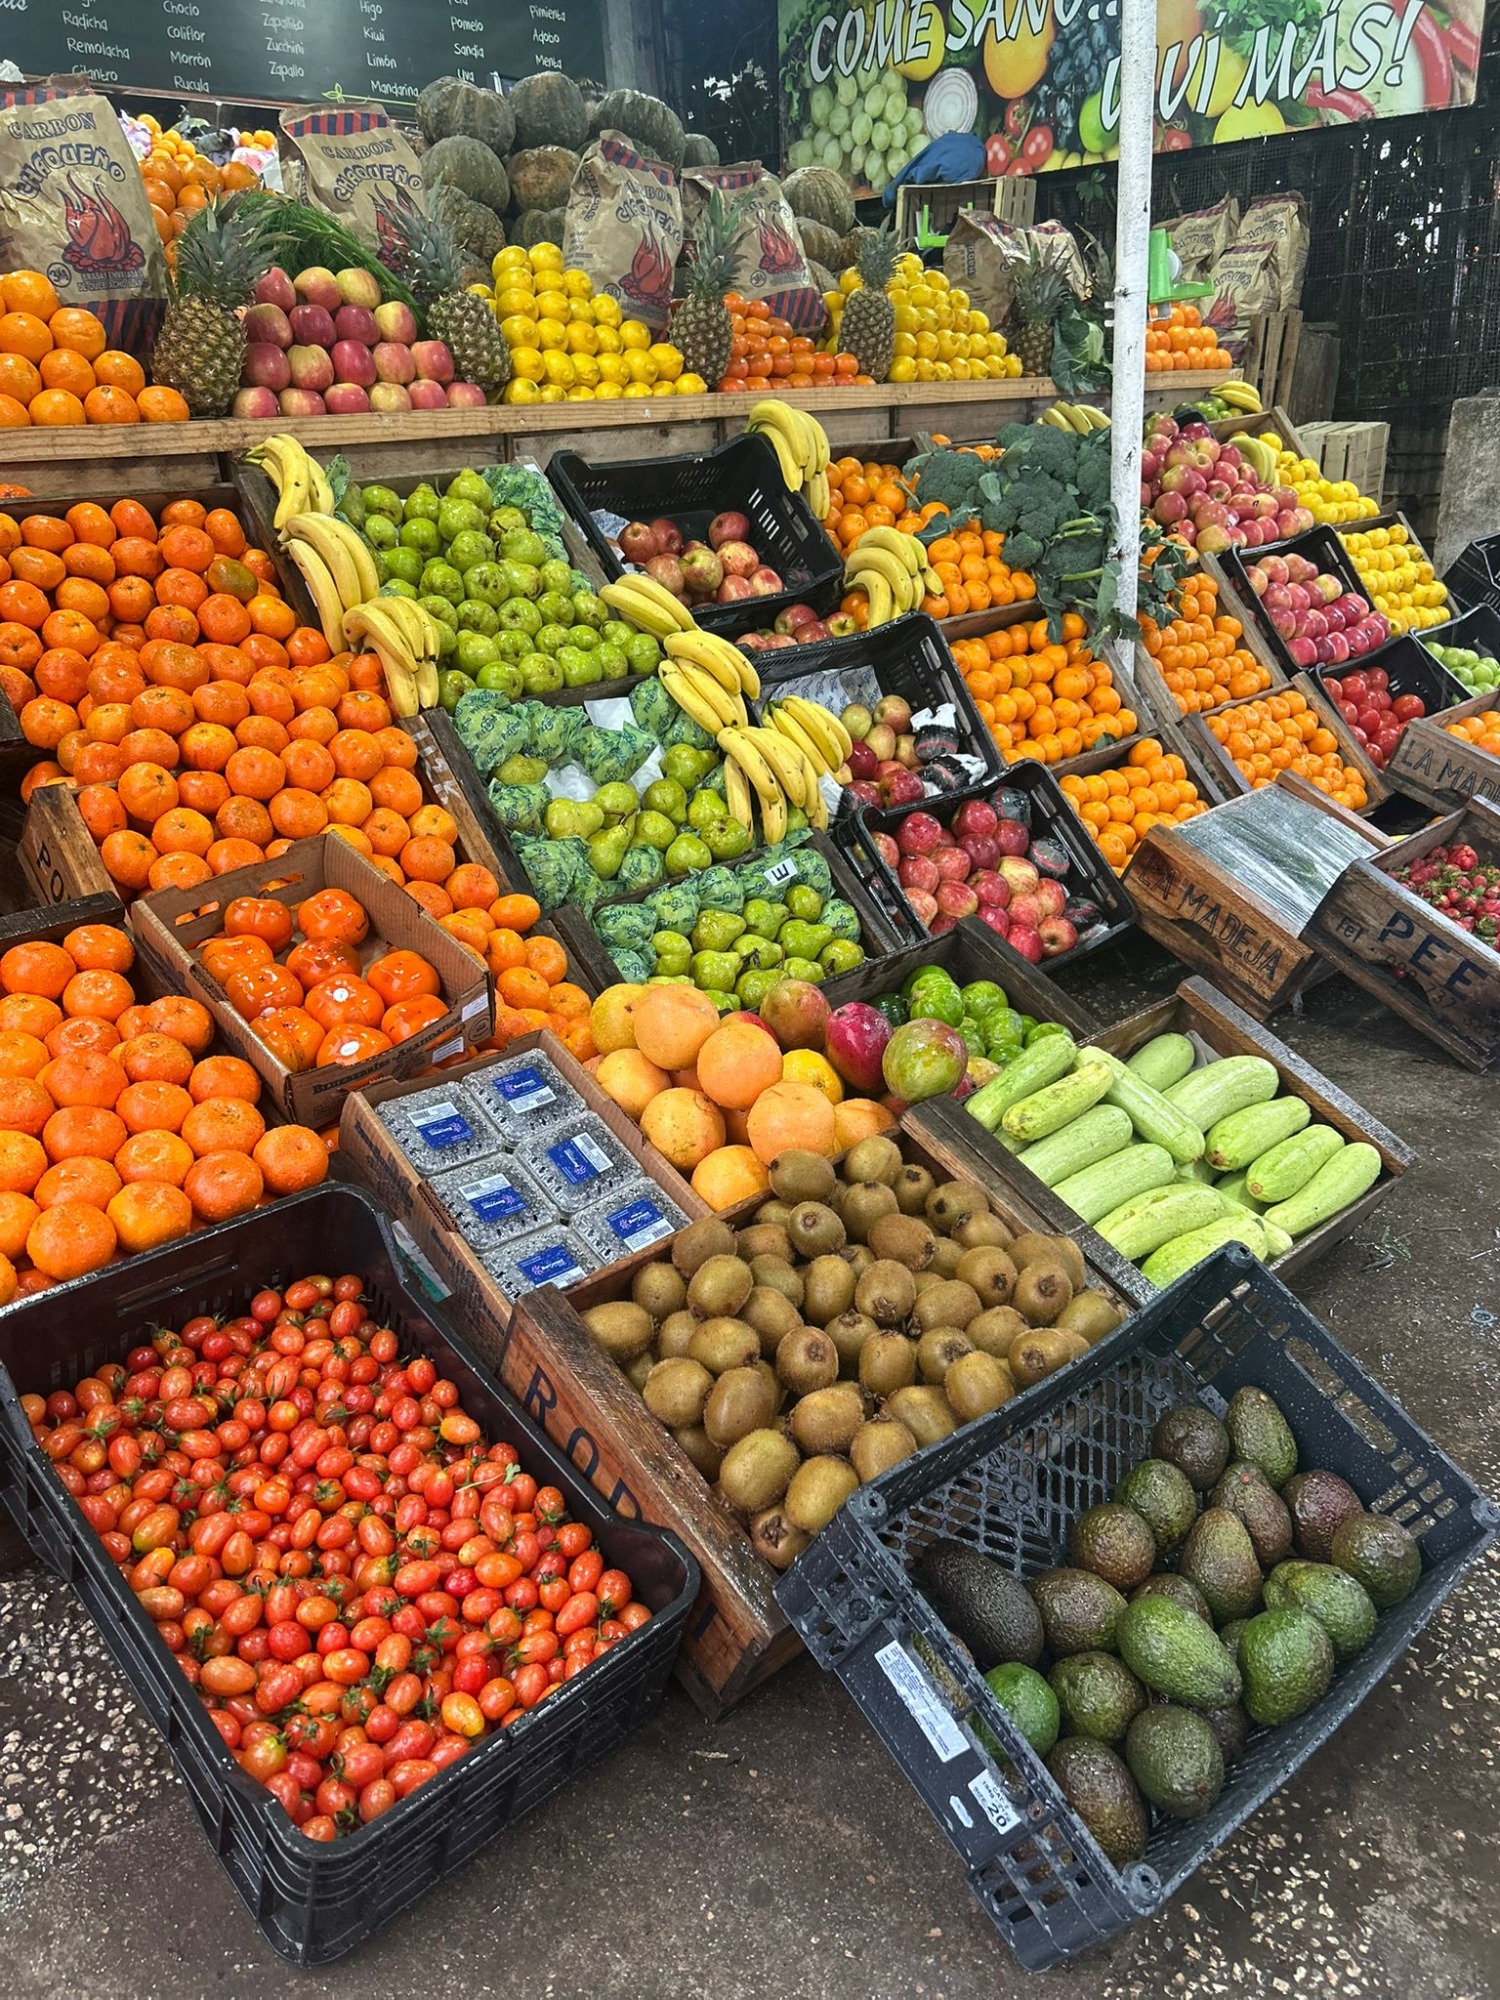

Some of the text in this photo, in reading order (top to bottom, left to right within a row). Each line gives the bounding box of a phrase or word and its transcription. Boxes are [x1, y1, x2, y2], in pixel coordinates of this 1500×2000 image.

[163, 1, 200, 16] Choclo
[360, 0, 383, 21] Higo
[529, 5, 566, 22] Pimienta
[62, 11, 109, 31] Radicha
[261, 13, 305, 34] Zapallito
[450, 16, 484, 32] Pomelo
[166, 25, 206, 43] Coliflor
[363, 27, 386, 42] Kiwi
[533, 29, 560, 43] Adobo
[809, 0, 931, 84] COME
[66, 37, 131, 60] Remolacha
[265, 37, 305, 55] Zucchini
[453, 42, 485, 59] Sandía
[1233, 0, 1424, 108] MÁS!
[170, 50, 212, 68] Morrón
[366, 52, 397, 69] Limón
[535, 54, 563, 70] Menta
[268, 61, 305, 82] Zapallo
[457, 68, 475, 83] Uva
[173, 75, 210, 94] Rucula
[370, 80, 420, 98] Mandarina
[7, 112, 97, 140] CARBON
[321, 138, 396, 161] CARBON
[15, 143, 126, 199] CHAQUEÑO
[333, 164, 423, 202] CHAQUEÑO
[1402, 740, 1500, 804] LA MAD
[1138, 868, 1285, 983] LA MADEJA
[1336, 914, 1364, 943] Tel
[987, 1802, 1007, 1828] 20
